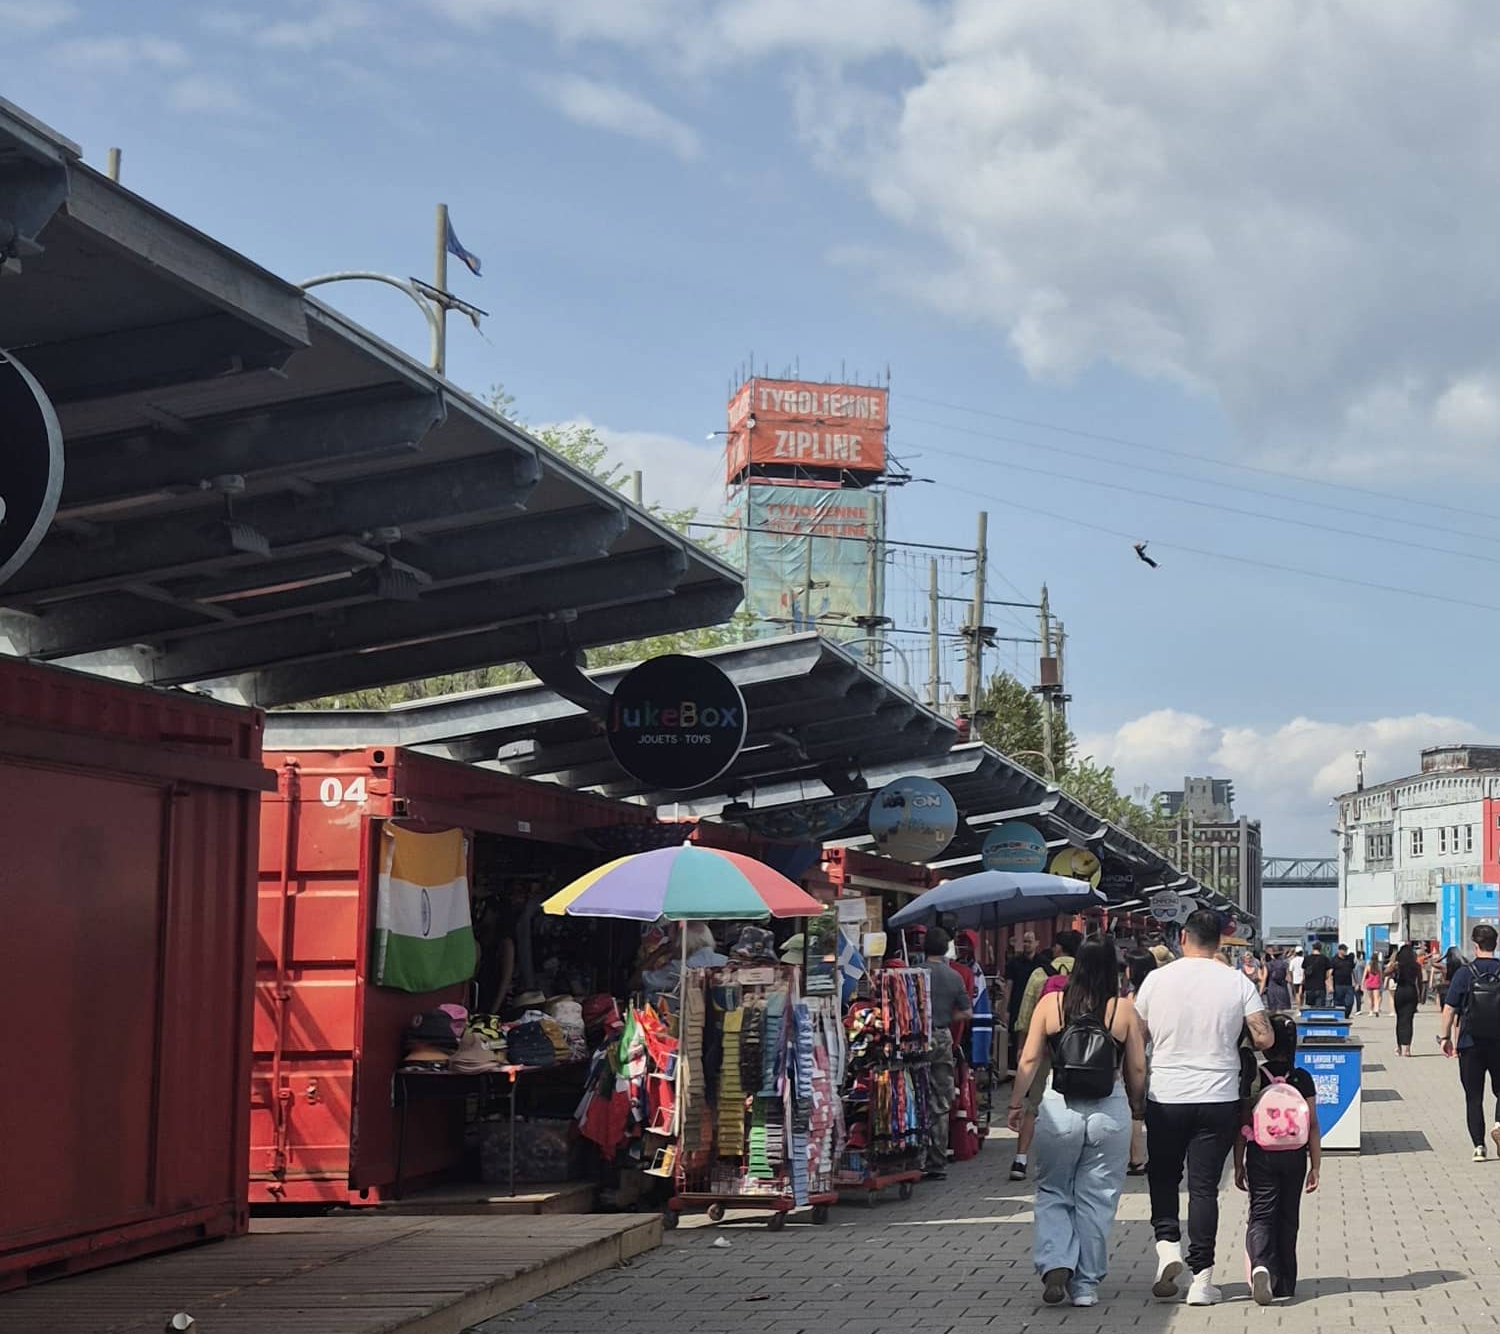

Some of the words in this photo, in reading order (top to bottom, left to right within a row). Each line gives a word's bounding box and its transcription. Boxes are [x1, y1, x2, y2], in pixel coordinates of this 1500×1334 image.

[759, 387, 881, 420] TYROLIENNE
[774, 429, 863, 462] ZIPLINE
[612, 700, 738, 732] JukeBox
[638, 734, 679, 745] JOUETS
[686, 734, 712, 745] TOYS
[320, 777, 368, 807] 04
